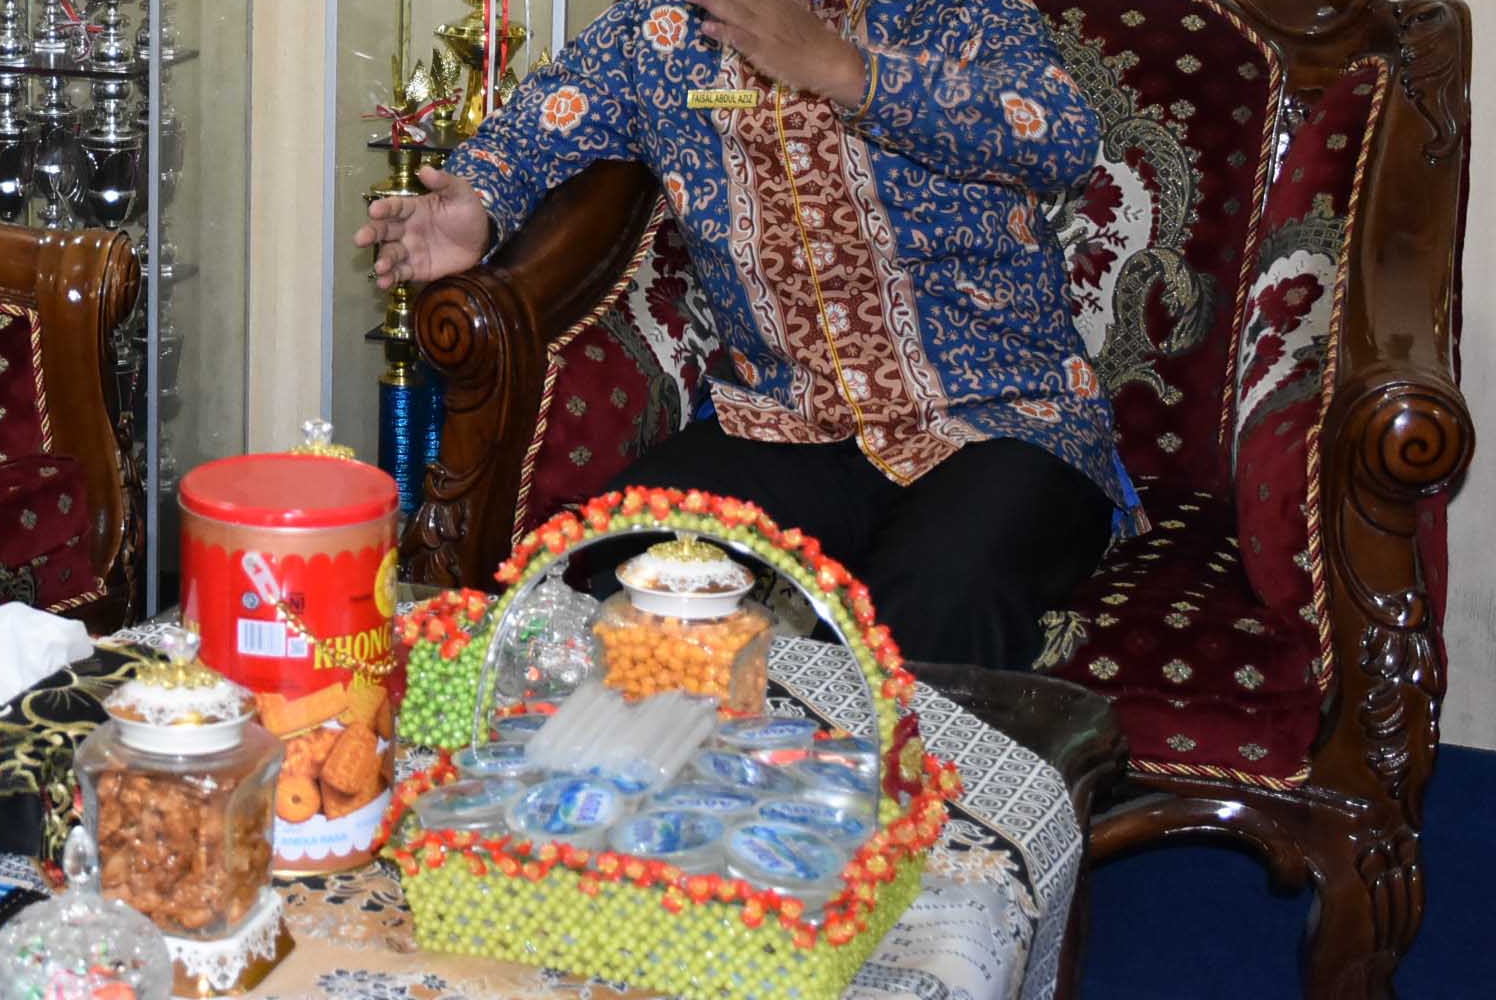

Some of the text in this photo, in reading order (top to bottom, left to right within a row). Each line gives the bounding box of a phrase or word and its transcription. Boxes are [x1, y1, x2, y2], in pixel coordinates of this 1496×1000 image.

[691, 93, 753, 104] FAISAL ABDUL AZIZ
